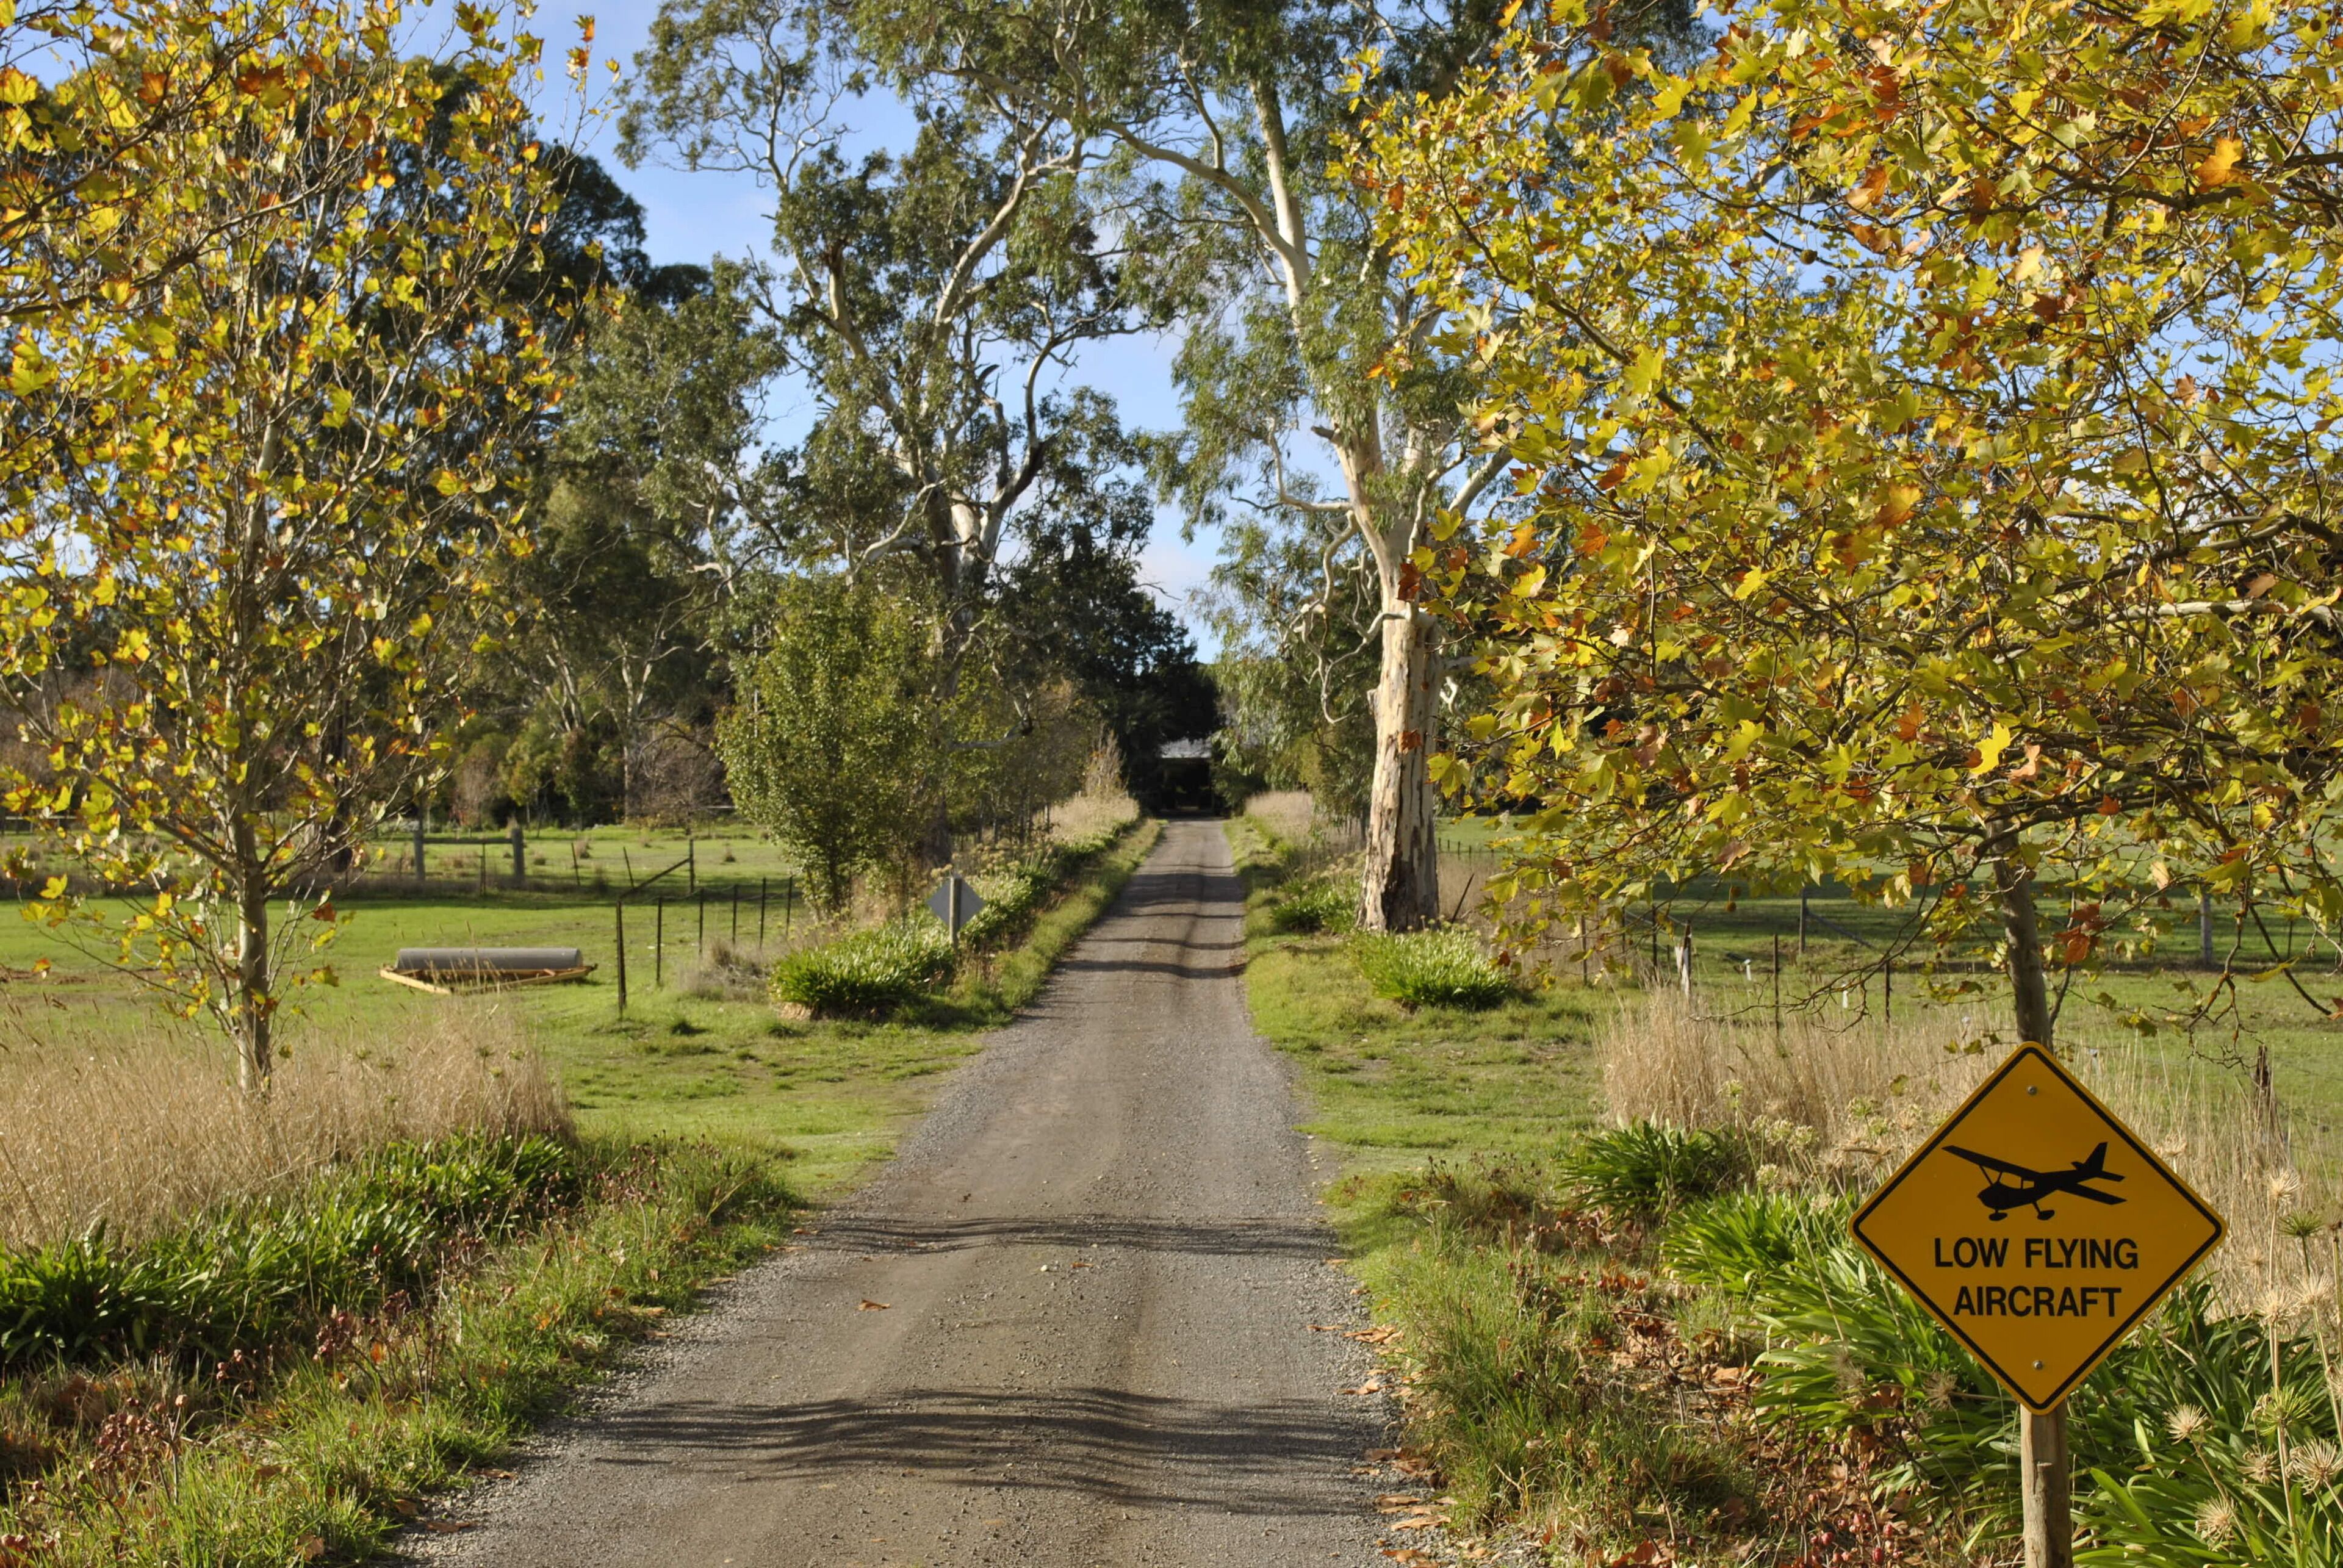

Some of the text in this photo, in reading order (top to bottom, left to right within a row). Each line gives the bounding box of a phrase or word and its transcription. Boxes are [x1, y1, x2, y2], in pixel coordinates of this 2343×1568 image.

[1934, 1237, 2138, 1269] LOW FLYING
[1953, 1286, 2122, 1317] AIRCRAFT
